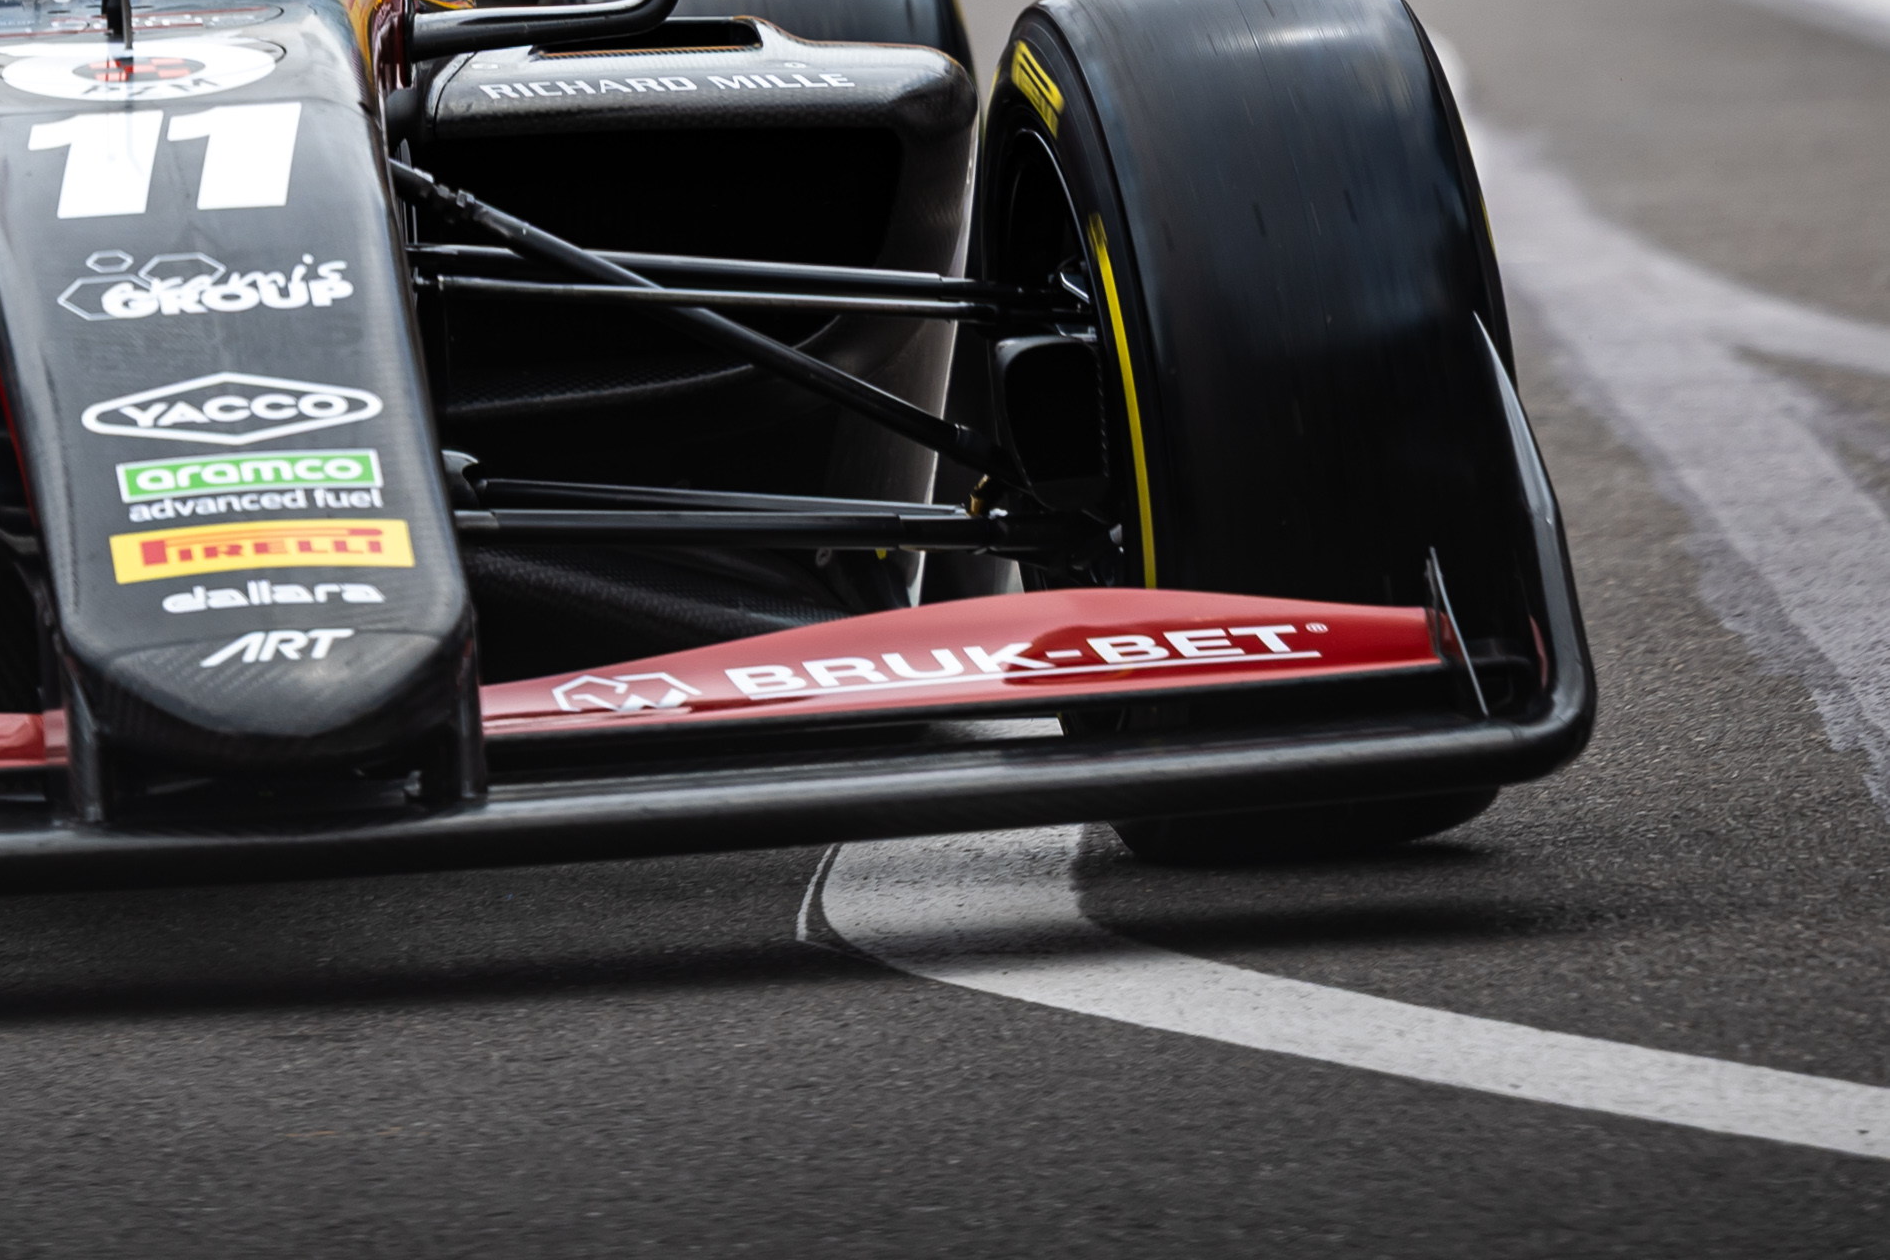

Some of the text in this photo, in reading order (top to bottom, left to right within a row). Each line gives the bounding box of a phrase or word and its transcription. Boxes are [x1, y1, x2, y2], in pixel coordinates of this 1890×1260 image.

[479, 72, 856, 100] RICHARD MILLE
[28, 101, 302, 219] 11
[101, 277, 354, 319] GROUP
[118, 392, 349, 428] YACCO
[135, 457, 364, 492] aramco
[129, 487, 384, 523] advanced fuel
[139, 526, 384, 568] PIRELLI
[162, 579, 386, 615] dallara
[200, 628, 355, 669] ART
